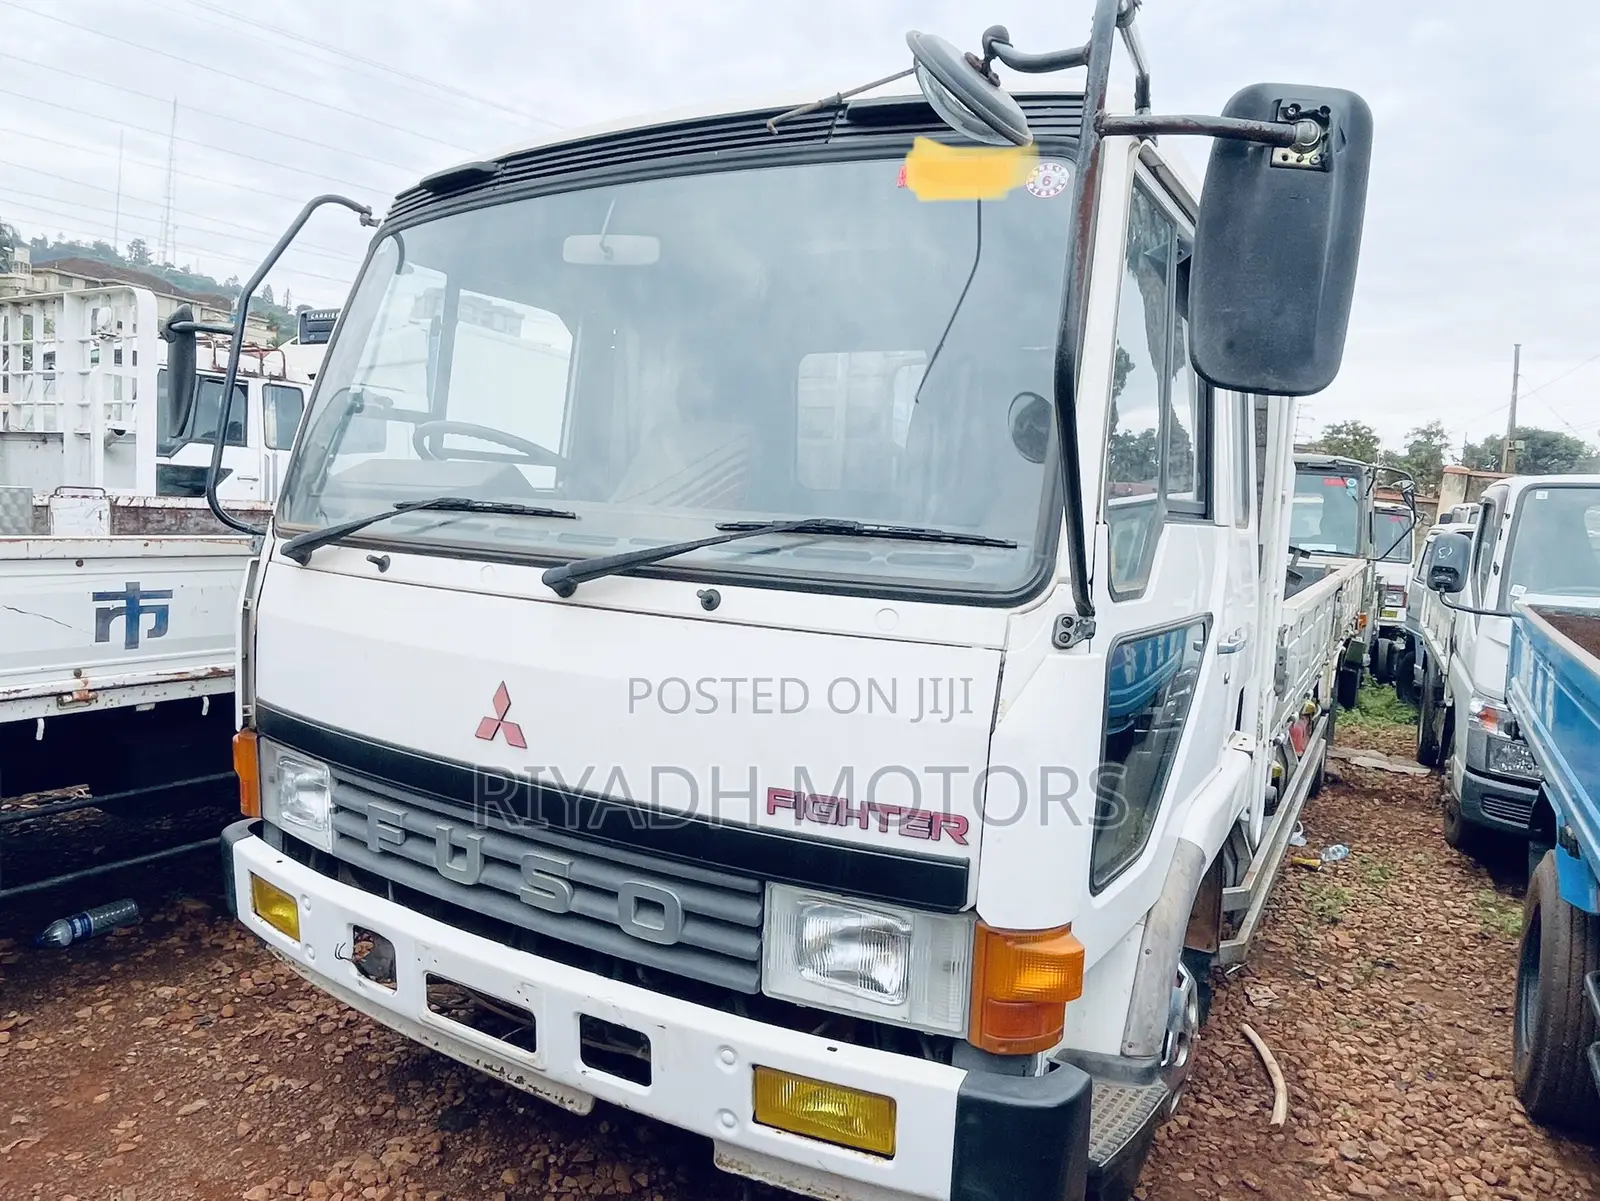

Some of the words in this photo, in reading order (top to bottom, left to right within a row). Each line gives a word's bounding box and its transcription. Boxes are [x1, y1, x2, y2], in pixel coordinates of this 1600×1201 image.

[1042, 175, 1052, 187] 6
[92, 581, 173, 650] 市
[765, 786, 970, 847] FIGHTER
[366, 800, 688, 945] FUSO
